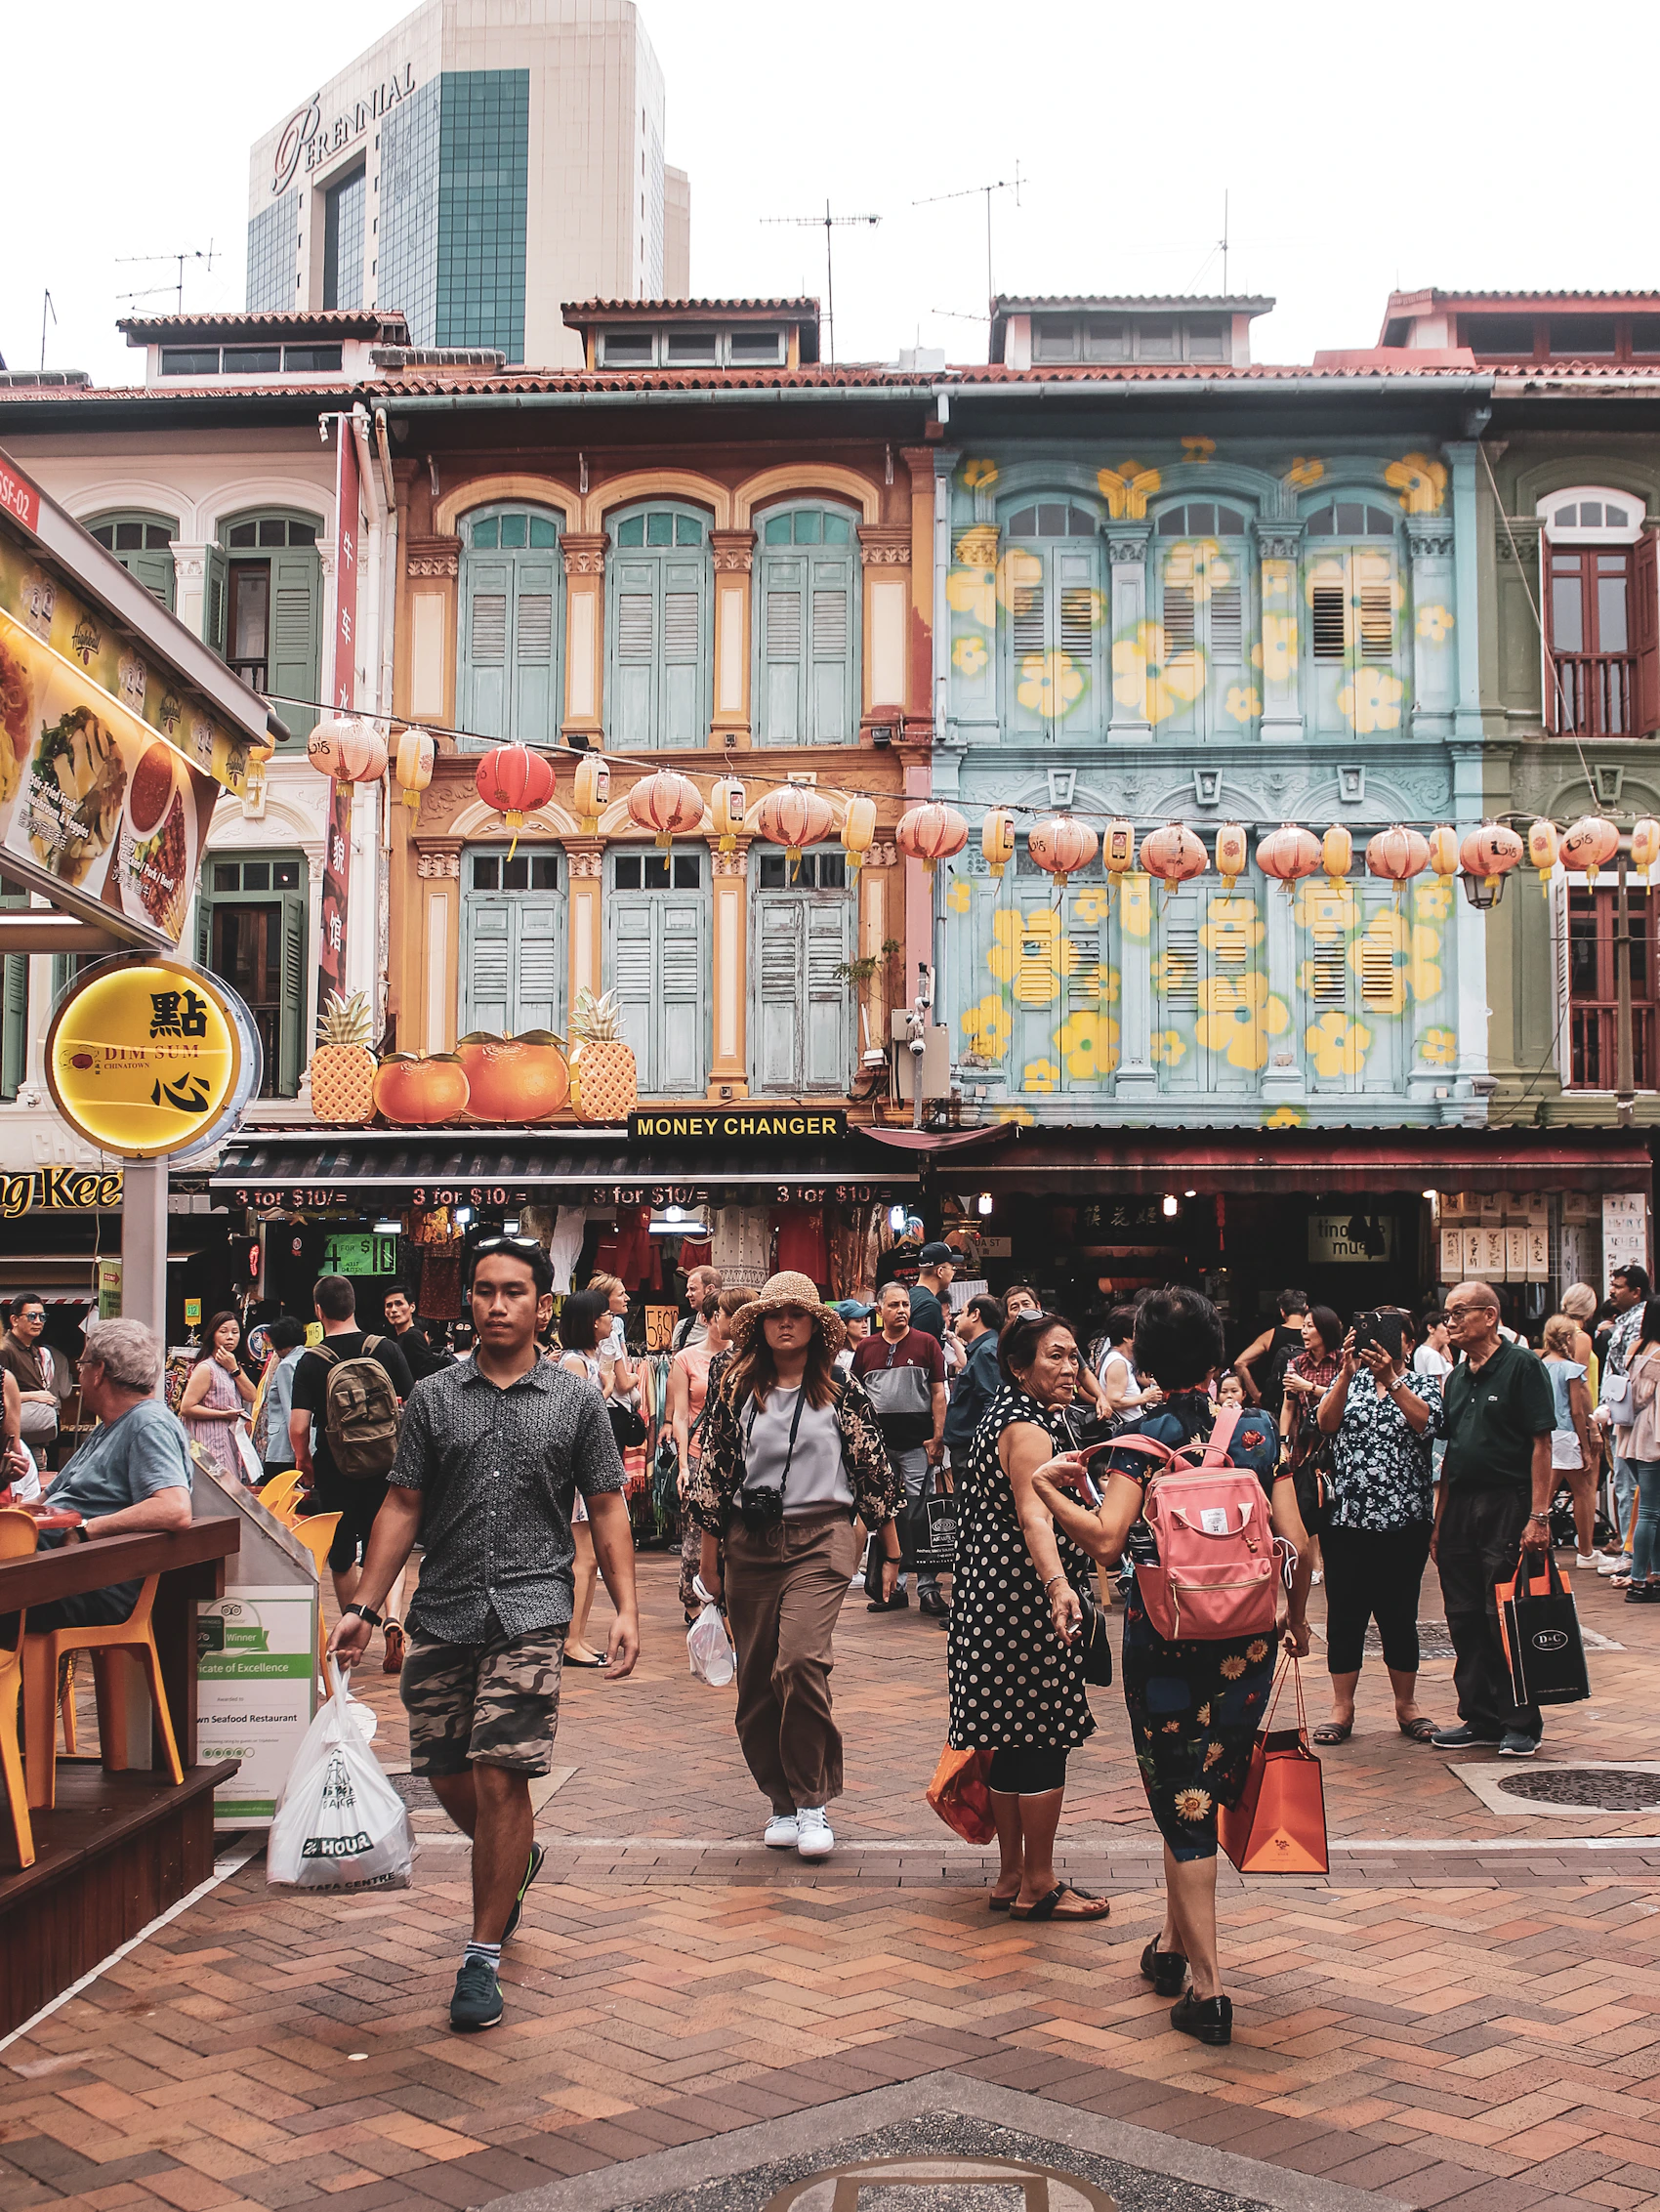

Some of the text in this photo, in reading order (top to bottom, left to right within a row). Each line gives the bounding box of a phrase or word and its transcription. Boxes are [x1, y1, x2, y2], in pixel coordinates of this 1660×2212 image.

[270, 63, 416, 195] PERENNIAL
[29, 772, 77, 813] Stir-Fried Fresh
[24, 789, 60, 820] Mushroom
[65, 814, 90, 838] Veggies
[104, 1044, 199, 1061] DIM SUM
[104, 1062, 150, 1070] CHINATOWN
[637, 1117, 837, 1136] MONEY CHANGER
[39, 1165, 123, 1209] Kee
[594, 1187, 606, 1204] 3
[613, 1186, 643, 1204] for
[776, 1186, 788, 1202] 3
[797, 1186, 827, 1203] for
[235, 1189, 248, 1205] 3
[255, 1189, 284, 1206] for
[413, 1189, 426, 1204] 3
[433, 1189, 463, 1205] for
[990, 1238, 1001, 1247] ST
[646, 1310, 658, 1348] 5
[227, 1633, 257, 1642] Winner
[226, 1663, 236, 1672] of
[237, 1662, 289, 1673] Excellence
[211, 1714, 248, 1724] Seafood
[249, 1714, 298, 1723] Restaurant
[321, 1834, 372, 1856] HOUR
[345, 1871, 395, 1889] CENTRE
